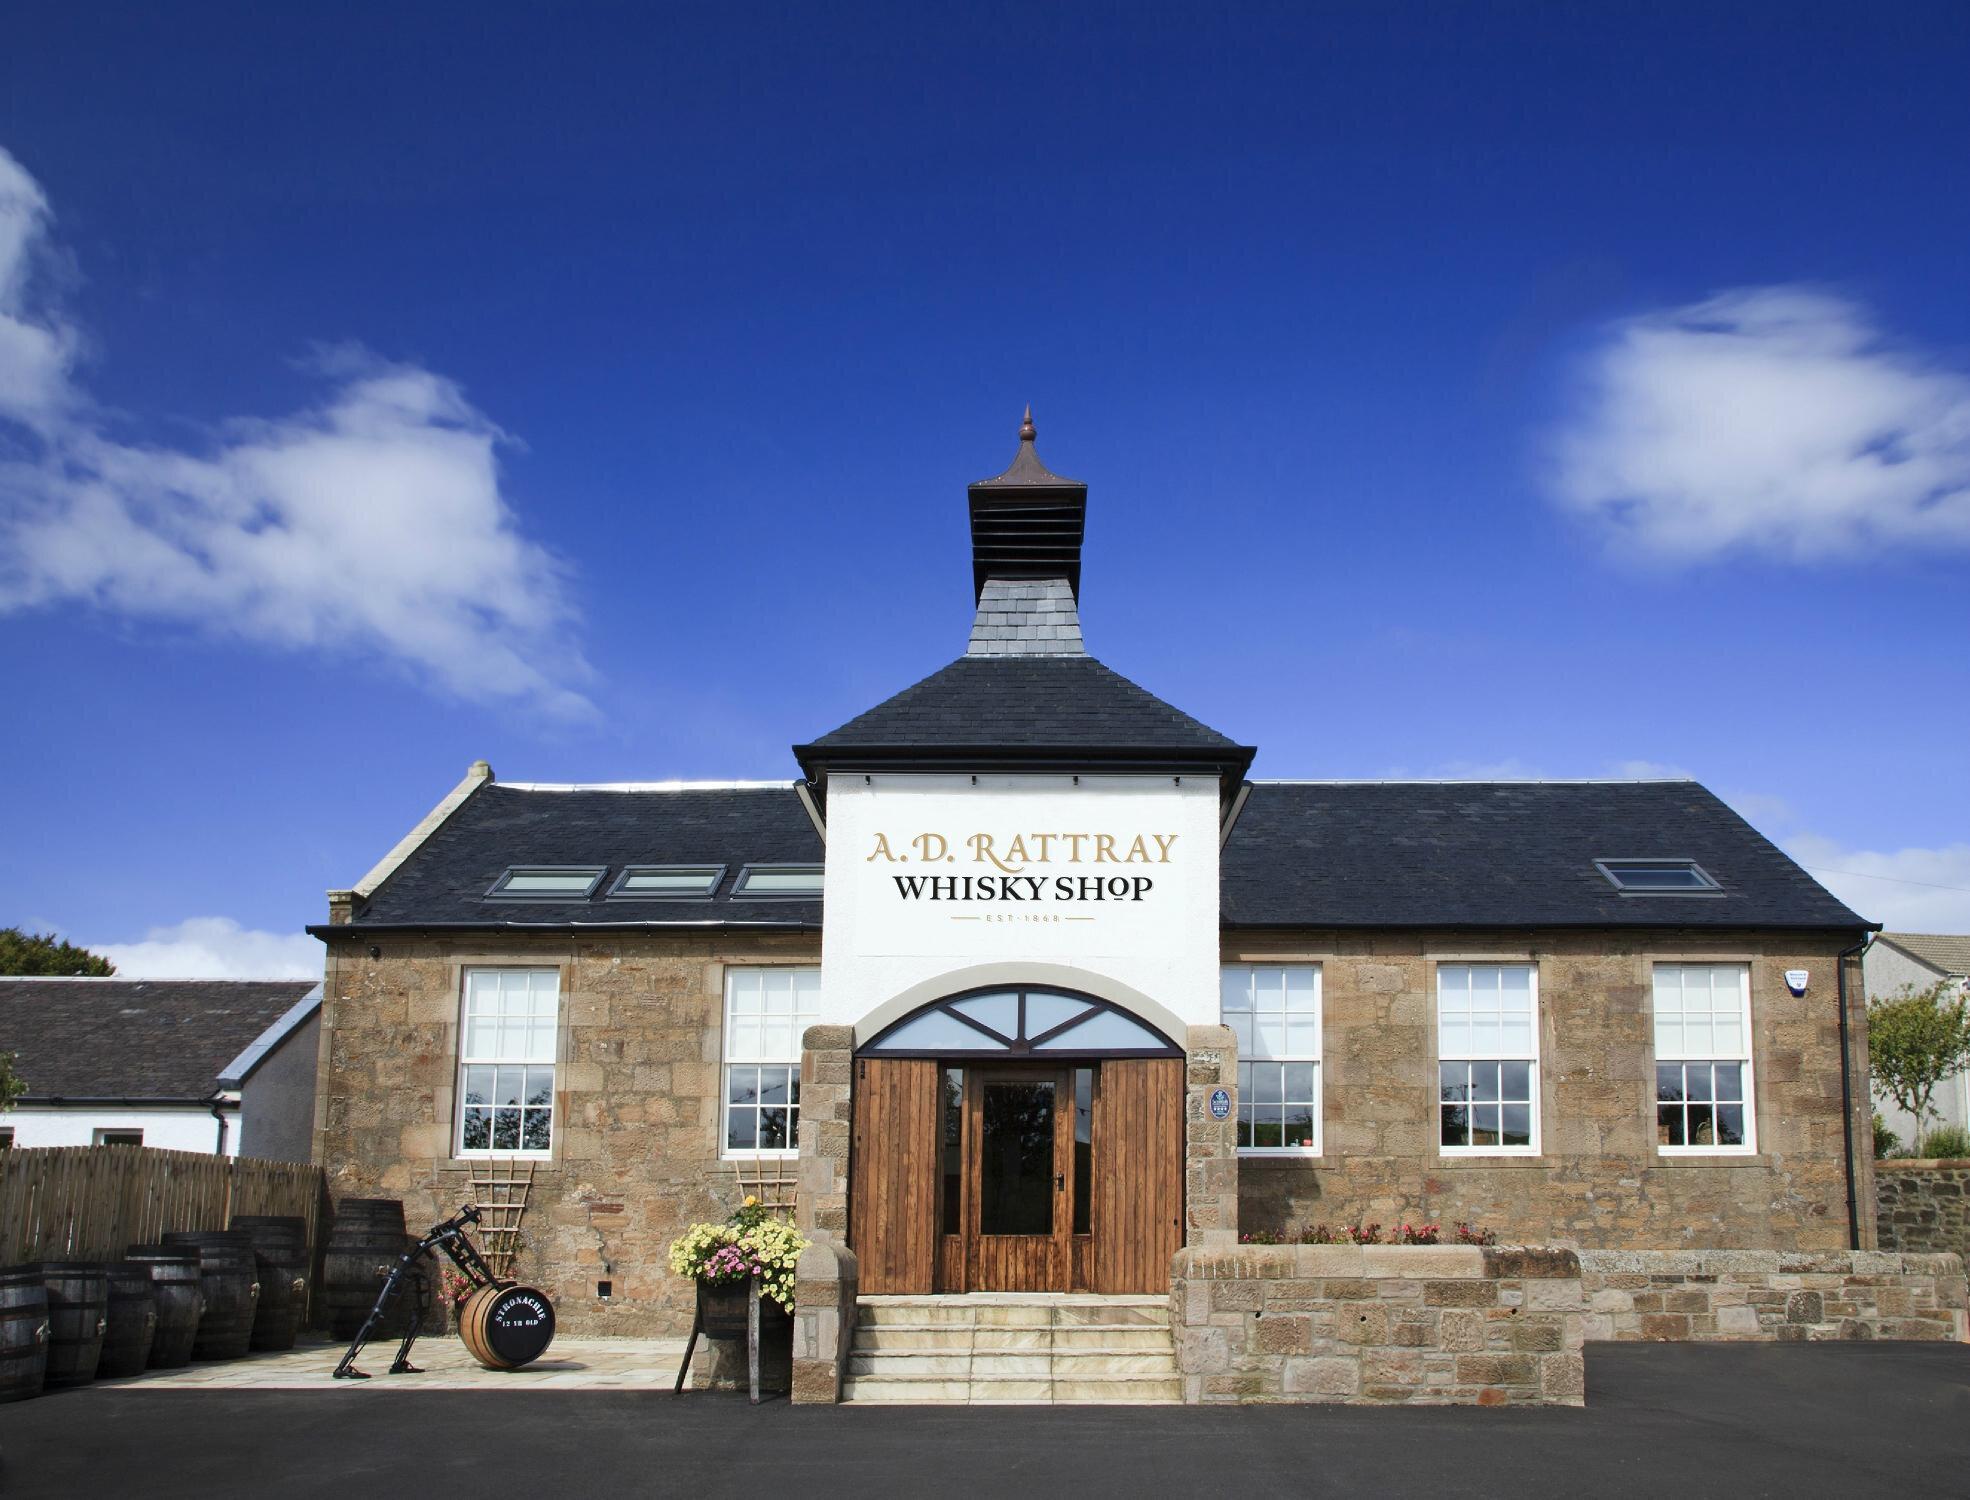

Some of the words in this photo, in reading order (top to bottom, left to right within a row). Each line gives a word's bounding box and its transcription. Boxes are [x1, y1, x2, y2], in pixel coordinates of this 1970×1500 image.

[967, 833, 1179, 874] RATTRAY
[892, 876, 1049, 901] WHISKY
[1055, 876, 1153, 902] SHOP
[495, 1296, 546, 1322] STRONACHIE
